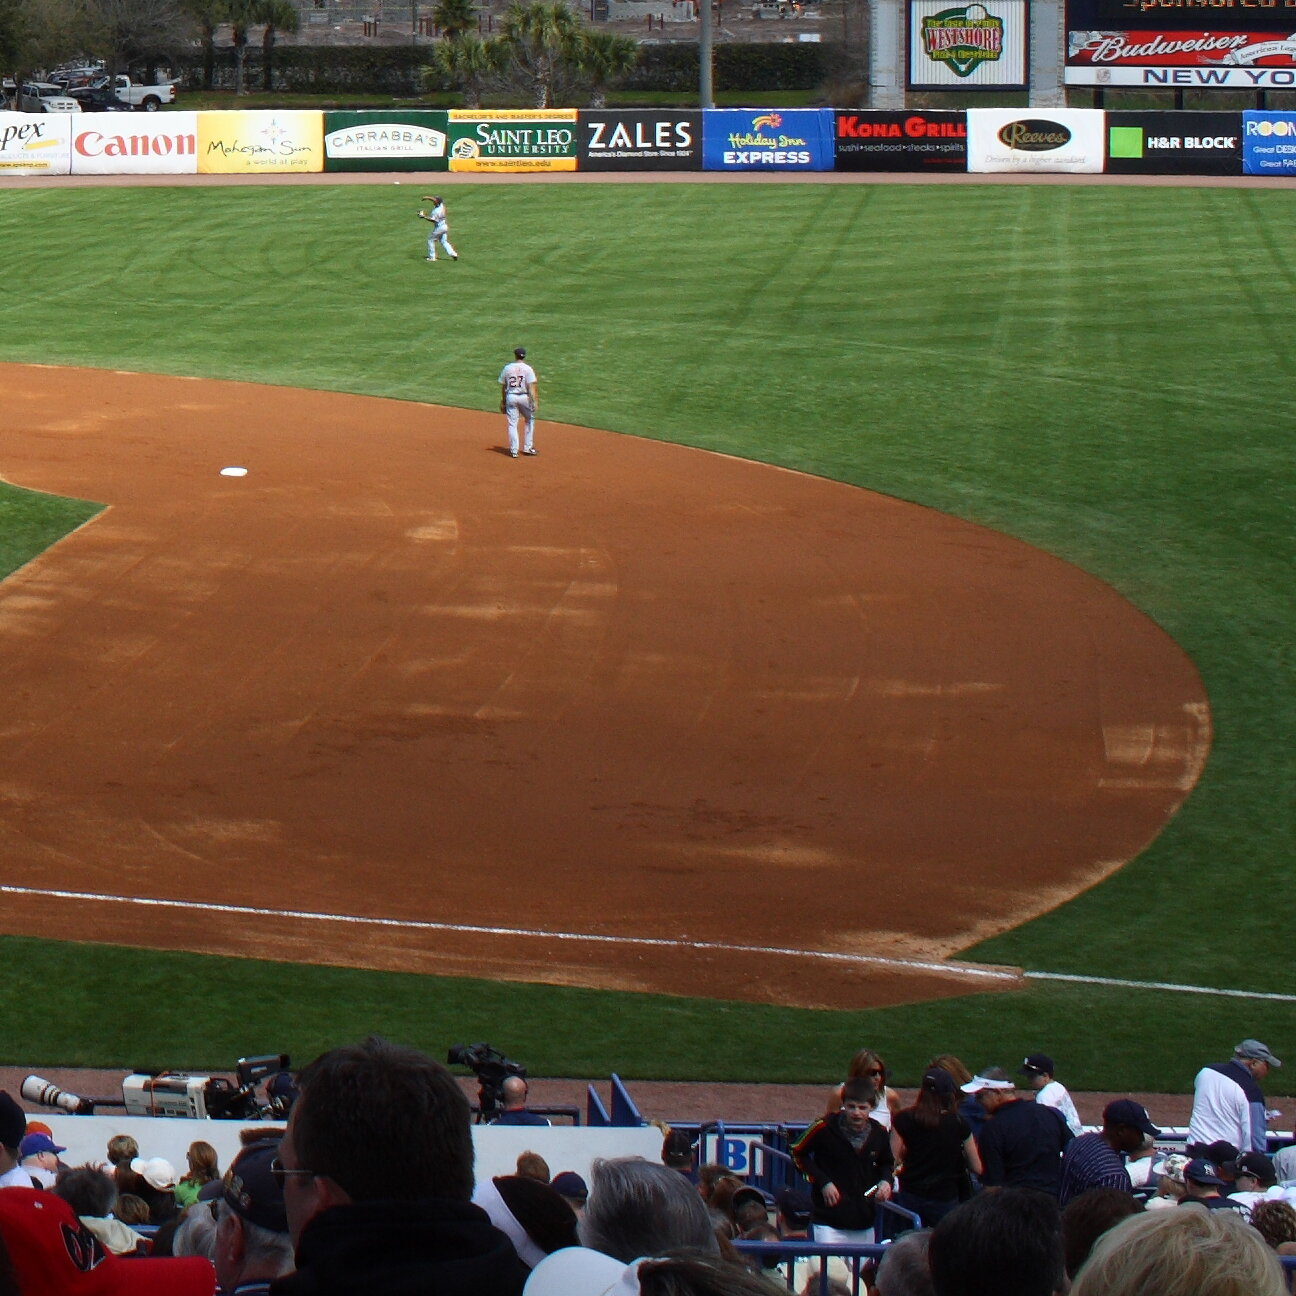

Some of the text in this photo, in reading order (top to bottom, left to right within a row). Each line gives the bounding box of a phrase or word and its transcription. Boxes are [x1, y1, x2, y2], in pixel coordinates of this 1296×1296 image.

[927, 27, 1001, 52] WESTSHORE
[1084, 32, 1248, 62] Budweiser
[1143, 69, 1296, 85] NEW YO
[332, 130, 439, 147] CARRABBA'S
[476, 123, 572, 145] SAINT LEO
[587, 121, 693, 148] ZALES
[728, 133, 807, 149] Holiday Inn
[1002, 122, 1068, 150] Reeves
[74, 131, 196, 157] Canon
[279, 140, 312, 156] Sun
[488, 145, 570, 154] UNIVERSITY
[1147, 136, 1236, 149] H&R BLOCK
[723, 151, 810, 164] EXPRESS
[509, 375, 525, 388] 27
